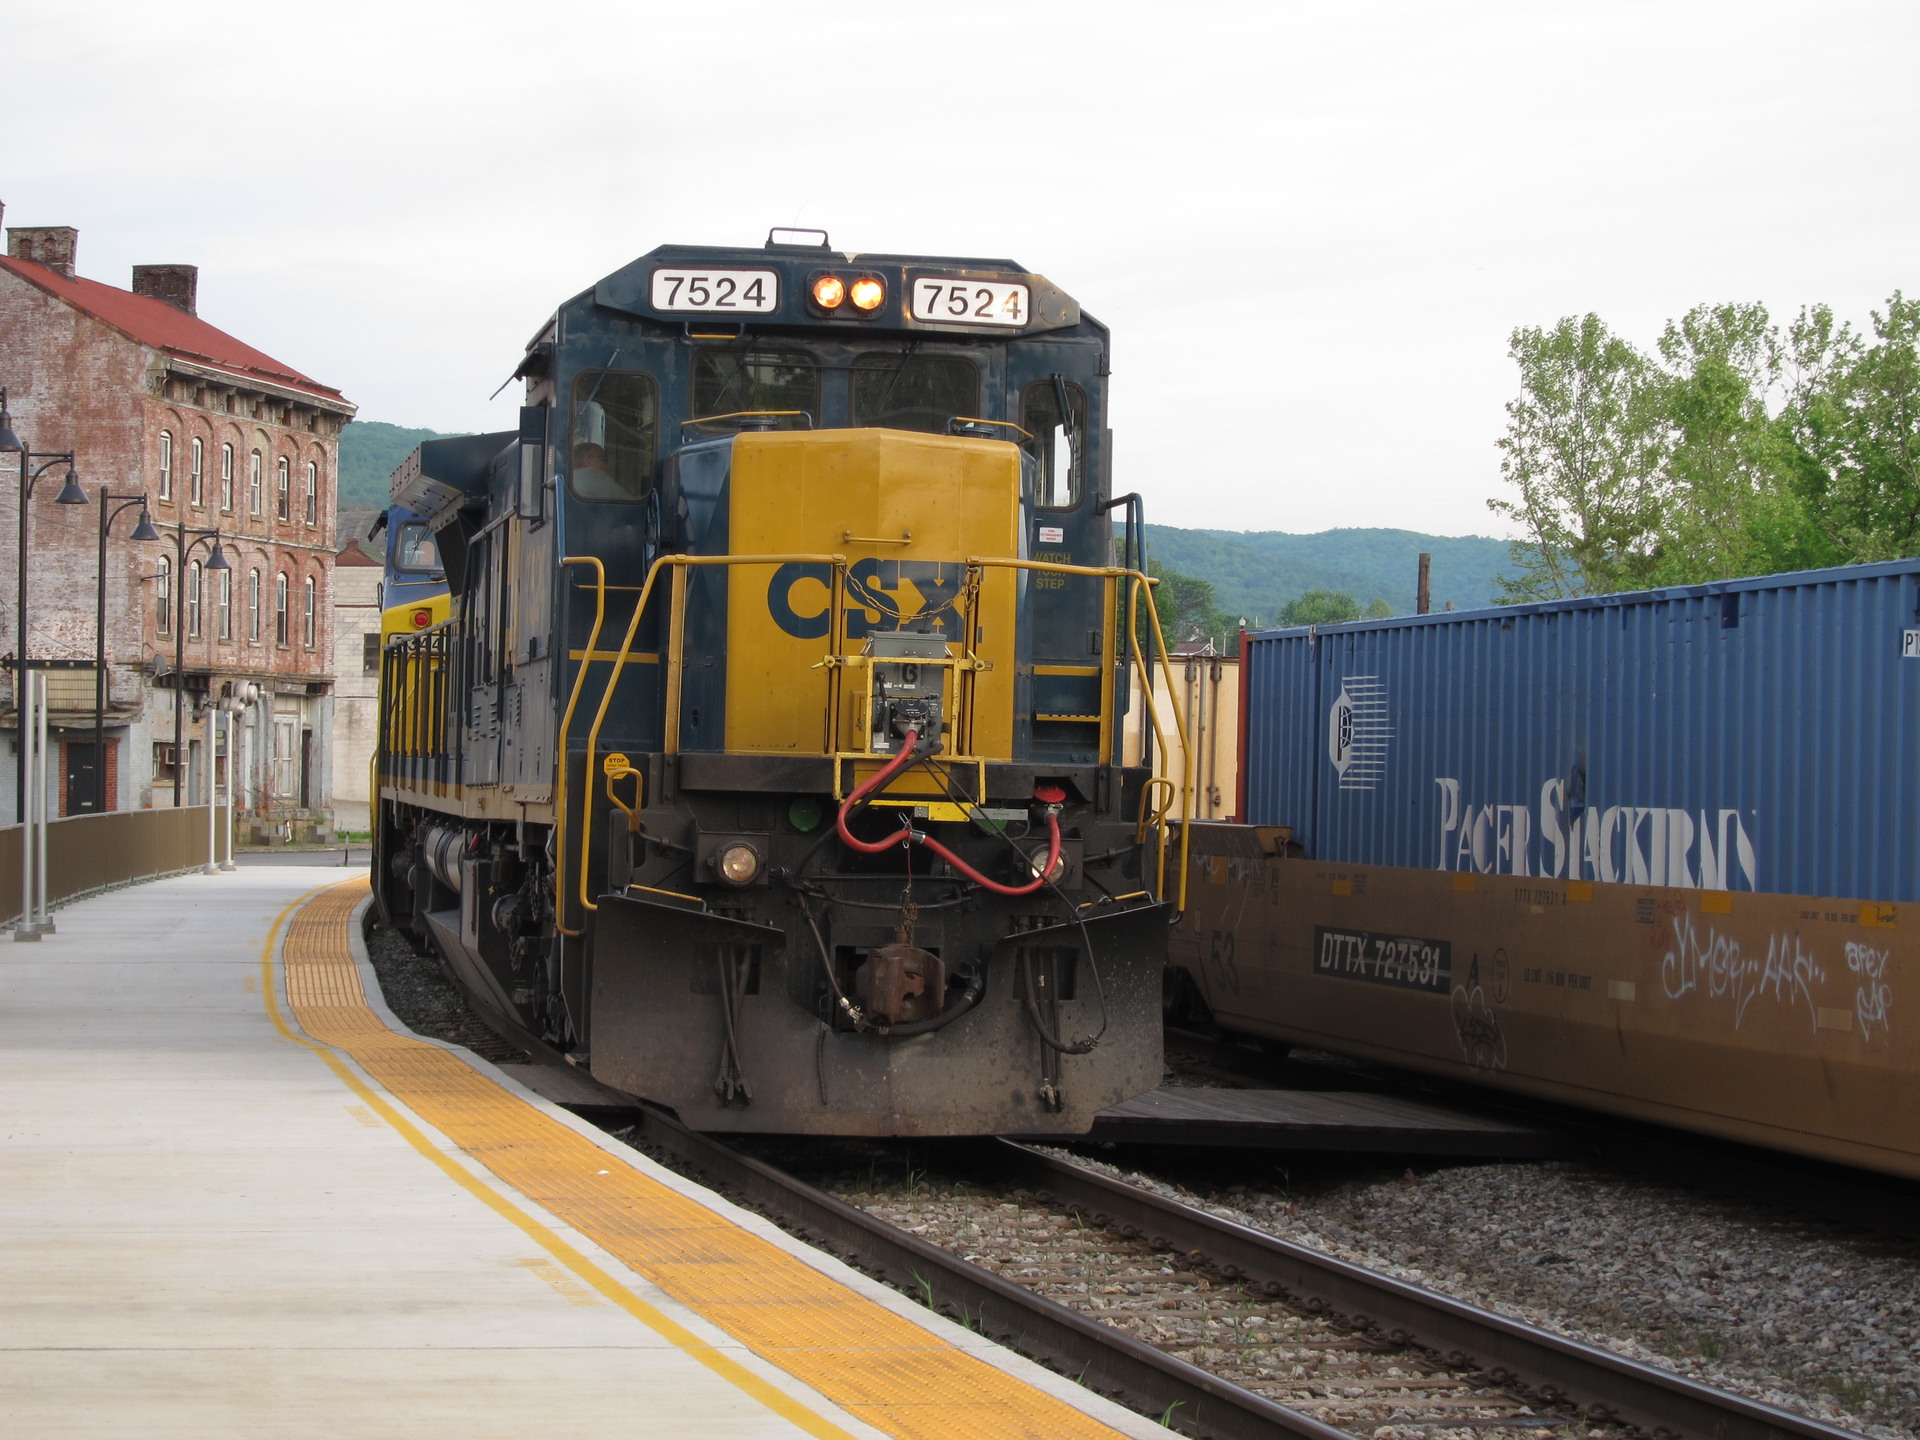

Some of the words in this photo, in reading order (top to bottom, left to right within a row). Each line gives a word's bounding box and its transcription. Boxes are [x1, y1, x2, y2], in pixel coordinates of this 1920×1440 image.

[664, 276, 766, 307] 7524
[923, 284, 1022, 320] 7524
[767, 557, 984, 643] CSX
[1036, 577, 1065, 589] STEP
[901, 663, 919, 684] 6
[1211, 929, 1240, 996] 53
[1320, 932, 1368, 975] DTTX
[1374, 940, 1441, 986] 727531
[1465, 952, 1480, 992] A
